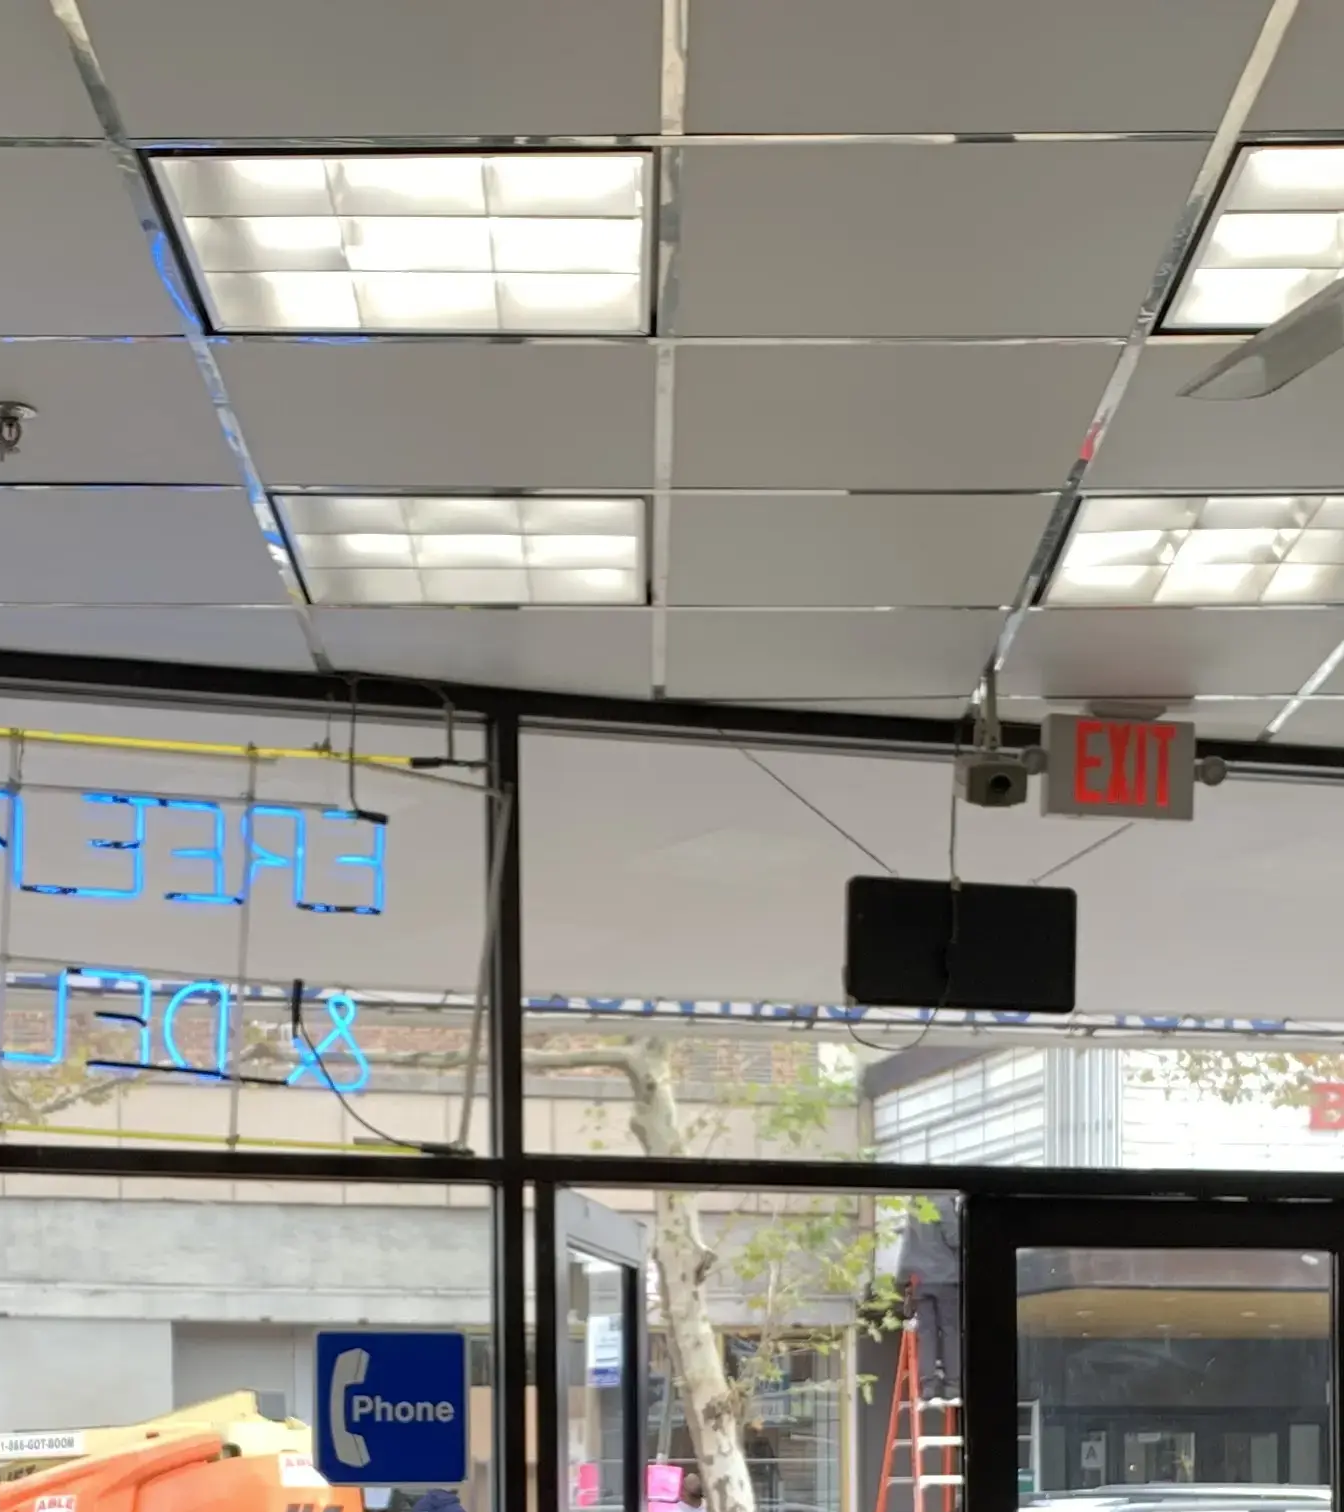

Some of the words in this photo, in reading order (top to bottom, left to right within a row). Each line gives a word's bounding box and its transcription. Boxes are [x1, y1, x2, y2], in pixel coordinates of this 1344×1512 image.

[1075, 720, 1177, 808] EXIT
[352, 1395, 454, 1423] Phone
[1085, 1445, 1098, 1460] A
